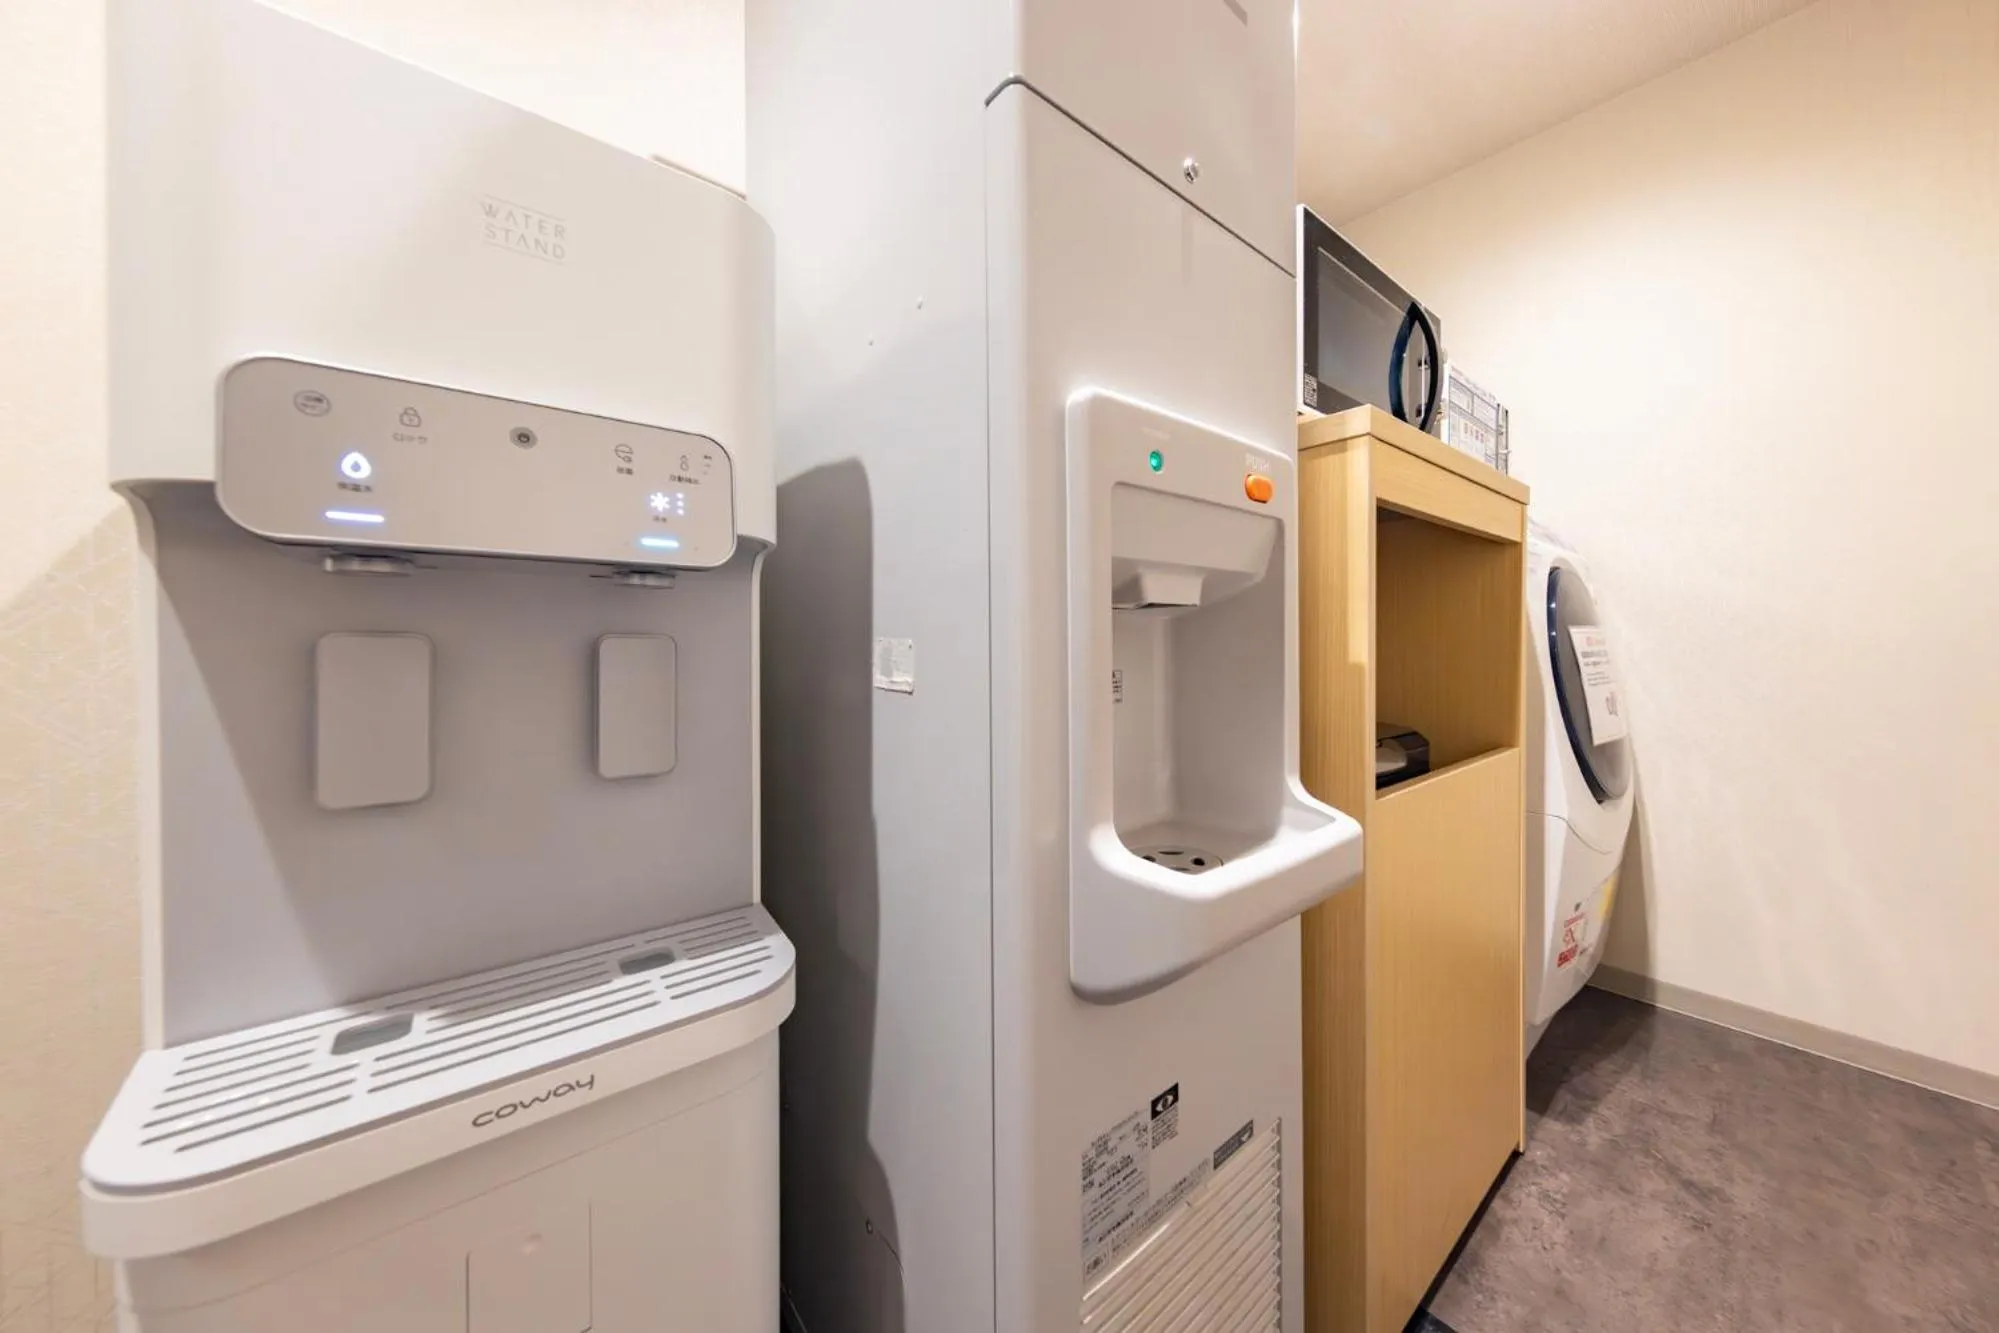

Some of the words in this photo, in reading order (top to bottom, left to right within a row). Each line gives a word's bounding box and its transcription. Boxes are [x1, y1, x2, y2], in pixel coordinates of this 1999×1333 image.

[479, 201, 566, 240] WATER
[483, 222, 566, 260] STAND
[471, 1074, 595, 1128] coway
